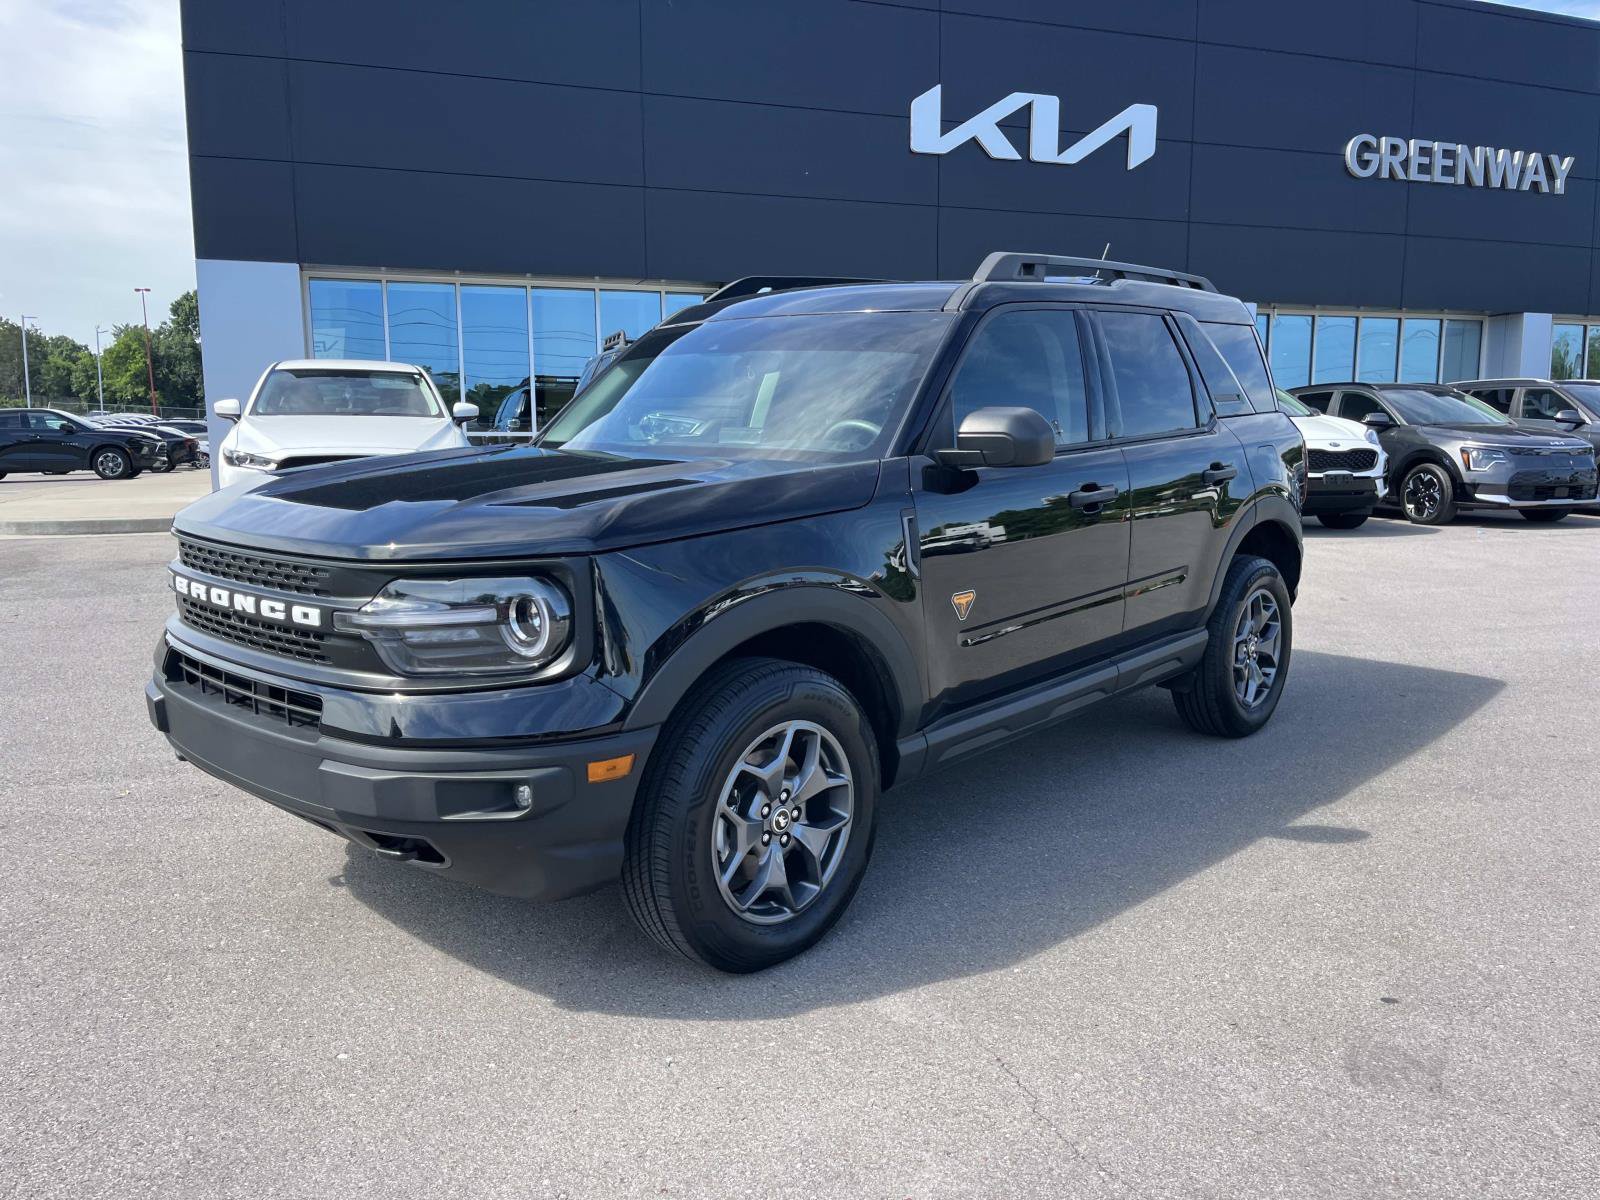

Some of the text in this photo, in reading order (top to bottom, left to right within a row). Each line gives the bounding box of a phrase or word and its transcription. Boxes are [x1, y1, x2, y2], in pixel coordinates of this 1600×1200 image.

[910, 84, 1158, 171] KIA
[1344, 133, 1575, 195] GREENWAY
[175, 576, 320, 626] BRONCO
